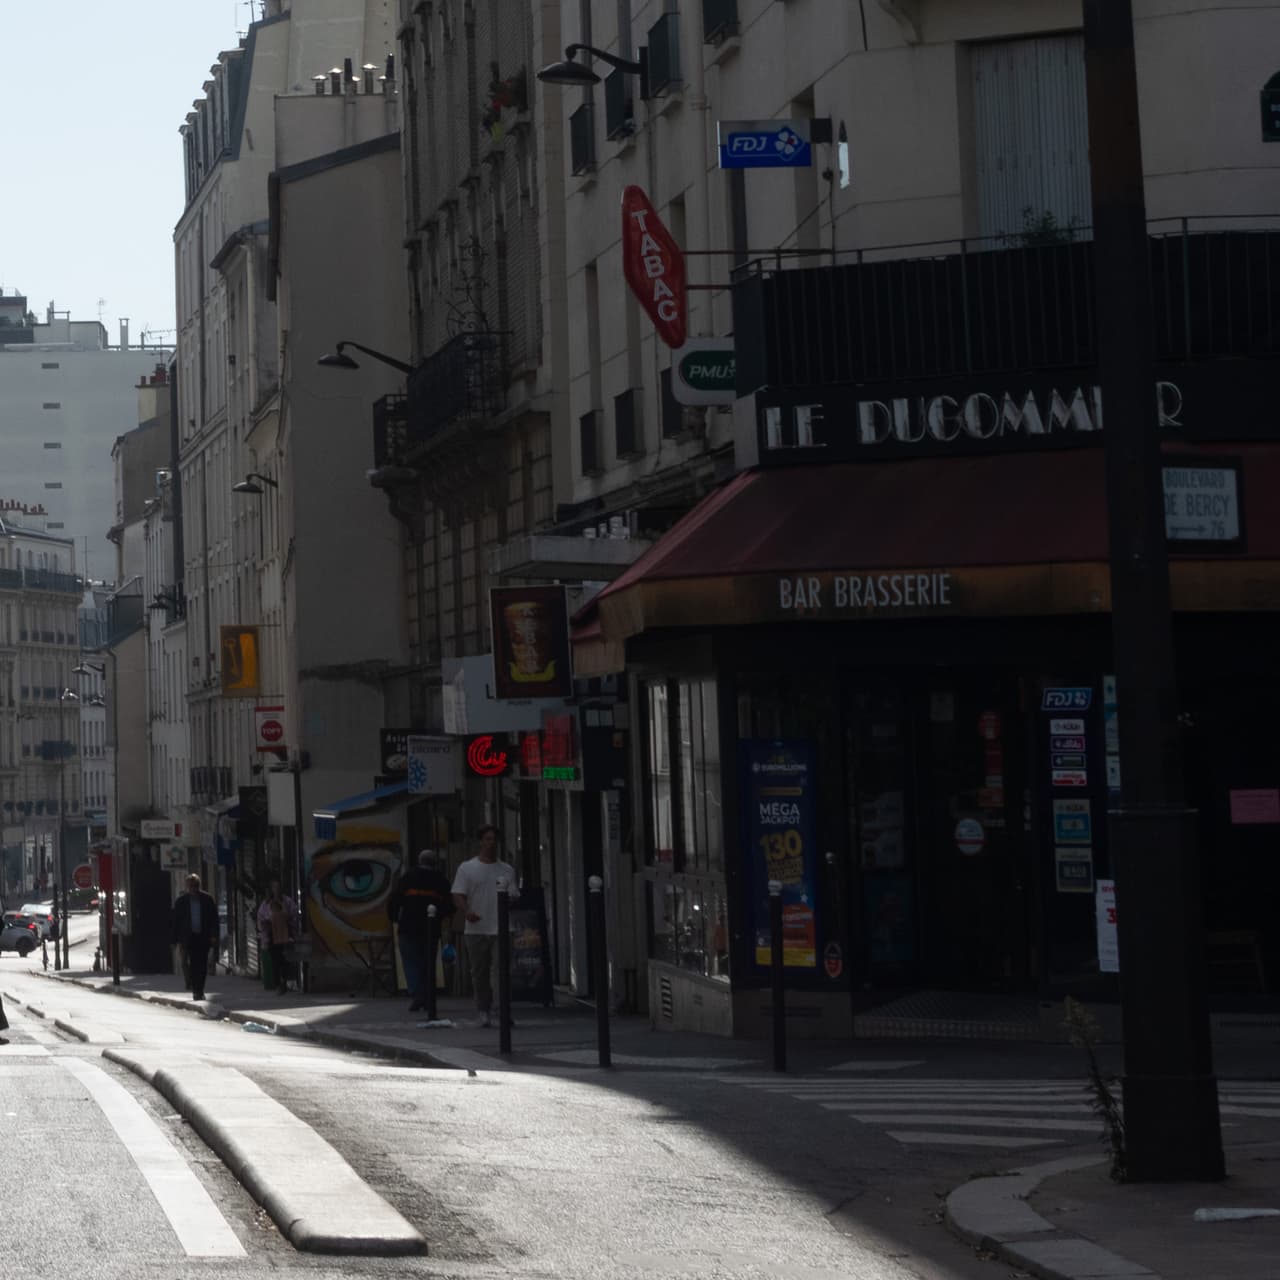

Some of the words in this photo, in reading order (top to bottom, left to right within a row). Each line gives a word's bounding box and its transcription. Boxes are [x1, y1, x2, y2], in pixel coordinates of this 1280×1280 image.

[732, 136, 768, 152] FDJ
[630, 208, 678, 322] TABAC
[762, 404, 828, 451] LE
[856, 382, 1185, 446] DUGOMMIR
[1186, 493, 1230, 517] BERCY
[779, 577, 822, 609] BAR
[834, 573, 953, 608] BRASSERIE
[1047, 691, 1073, 706] FDJ
[759, 815, 801, 825] JACKPOT
[760, 829, 803, 861] 130
